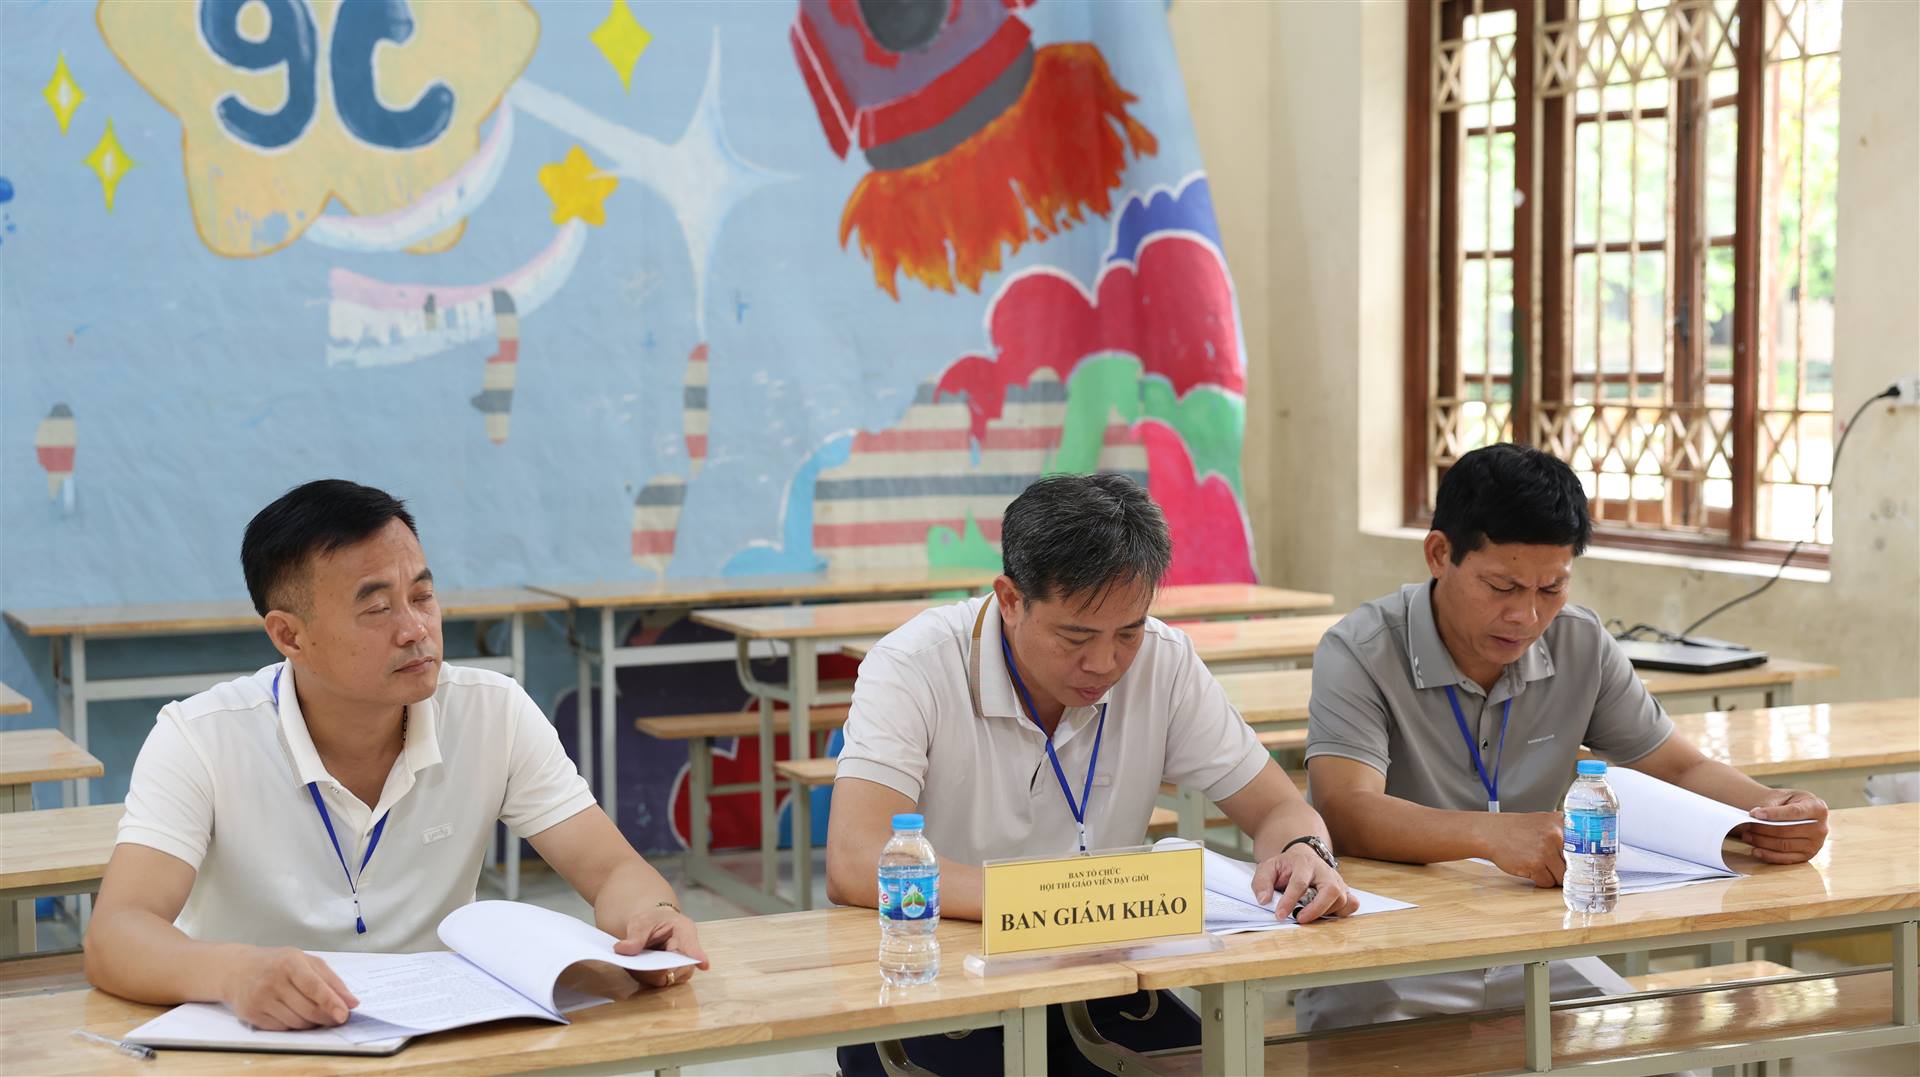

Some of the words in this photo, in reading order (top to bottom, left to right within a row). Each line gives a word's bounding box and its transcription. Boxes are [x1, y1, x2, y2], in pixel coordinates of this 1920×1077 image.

[199, 0, 456, 151] 9C
[1056, 881, 1071, 890] THI
[1071, 878, 1092, 889] GIÁO
[1114, 876, 1130, 886] DẠY
[1068, 871, 1085, 880] BAN
[1000, 910, 1047, 931] BAN
[1053, 900, 1116, 926] GIÁM
[1122, 893, 1188, 919] KHẢO
